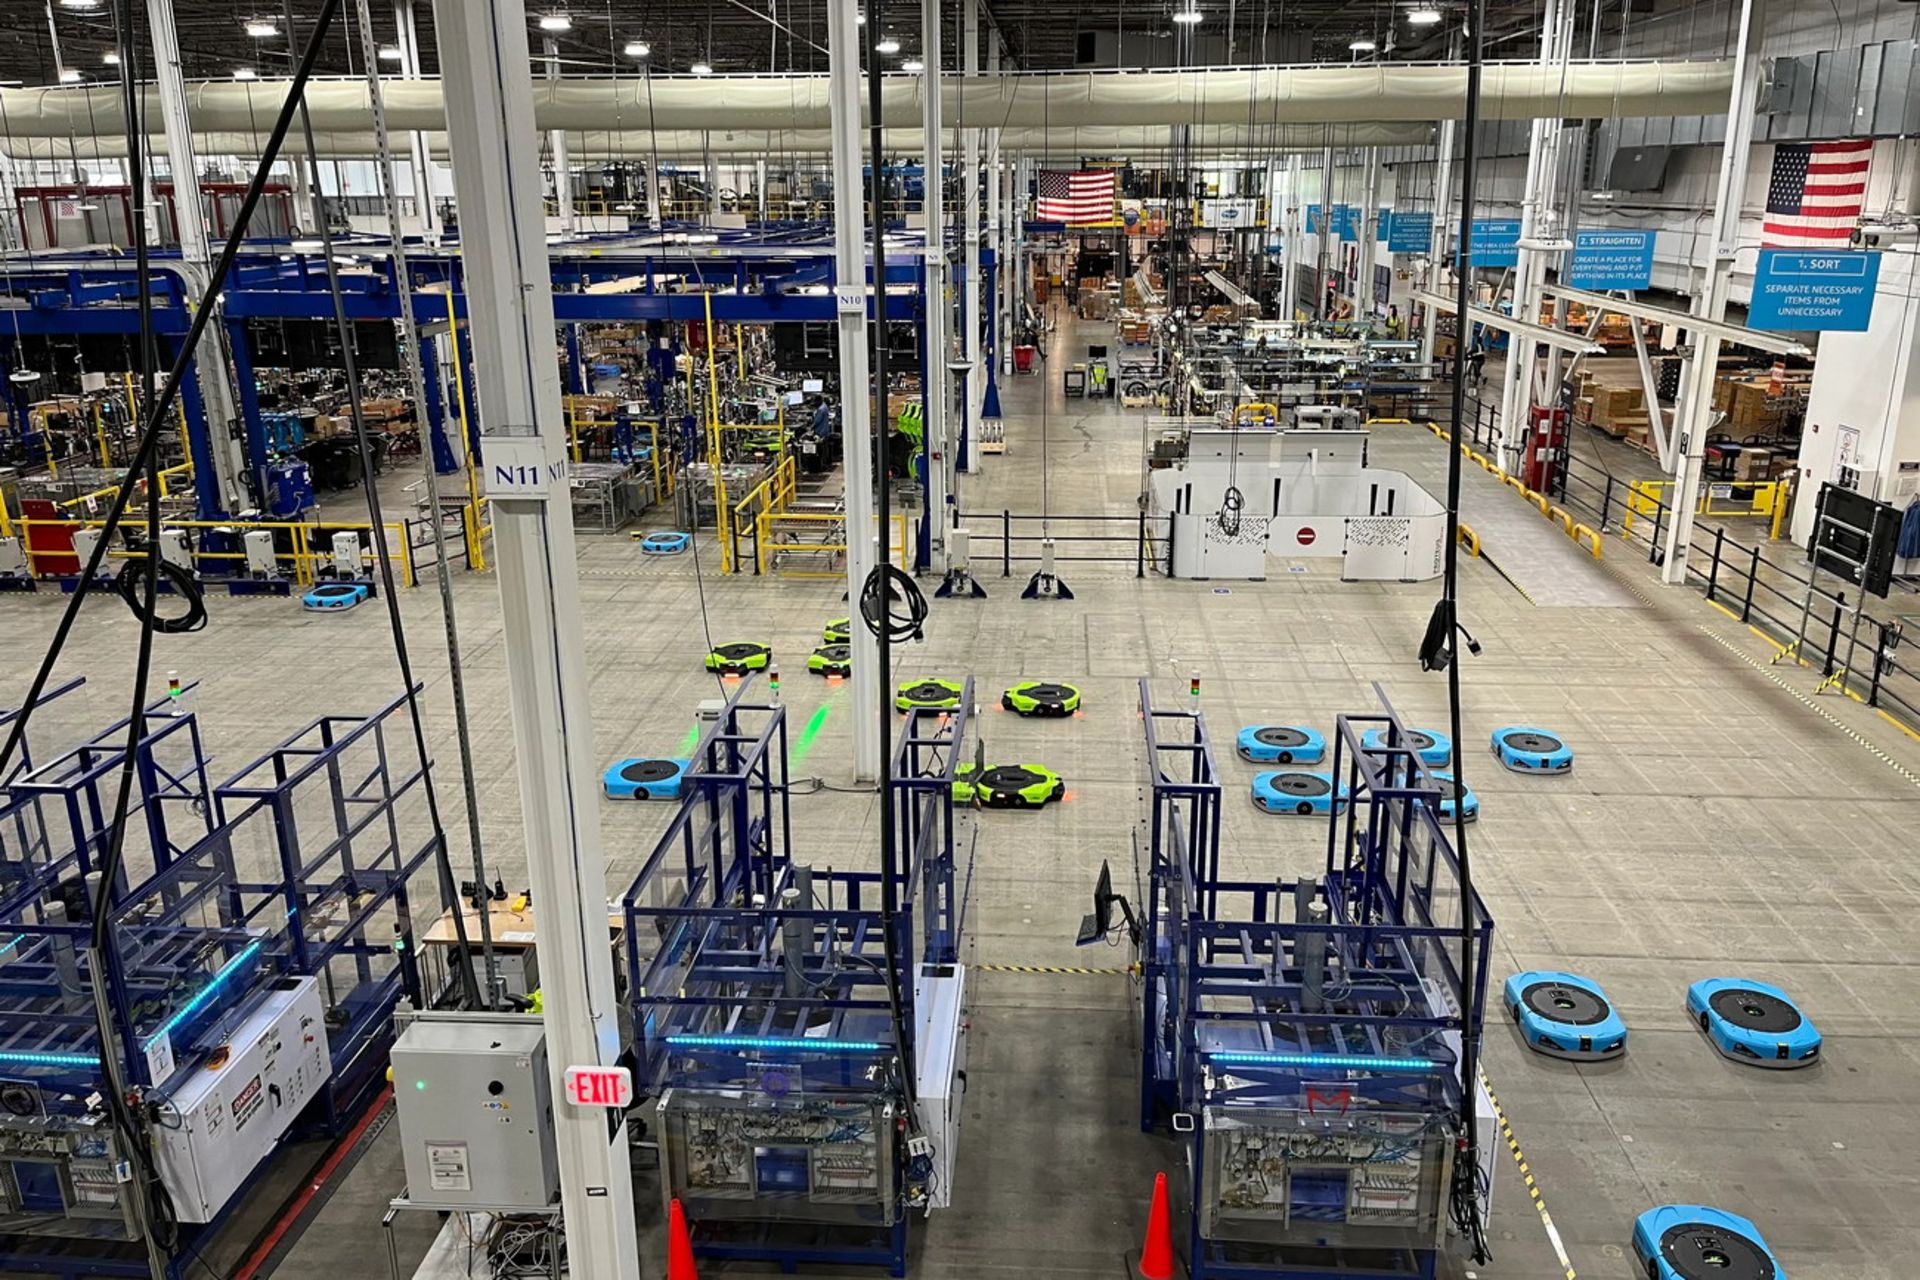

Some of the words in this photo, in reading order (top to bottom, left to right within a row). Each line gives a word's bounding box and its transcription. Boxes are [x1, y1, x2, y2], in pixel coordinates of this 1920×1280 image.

[1589, 237, 1641, 245] STRAIGHTEN
[1798, 259, 1808, 269] 1.
[1810, 259, 1841, 269] SORT
[1765, 284, 1809, 293] SEPARATE
[1811, 286, 1864, 295] NECESSARY
[841, 295, 861, 304] N10
[1784, 296, 1812, 304] ITEMS
[1813, 297, 1841, 305] FROM
[1777, 308, 1843, 316] UNNECESSARY
[496, 465, 538, 485] N11
[548, 459, 565, 483] N11
[576, 1073, 620, 1104] EXIT
